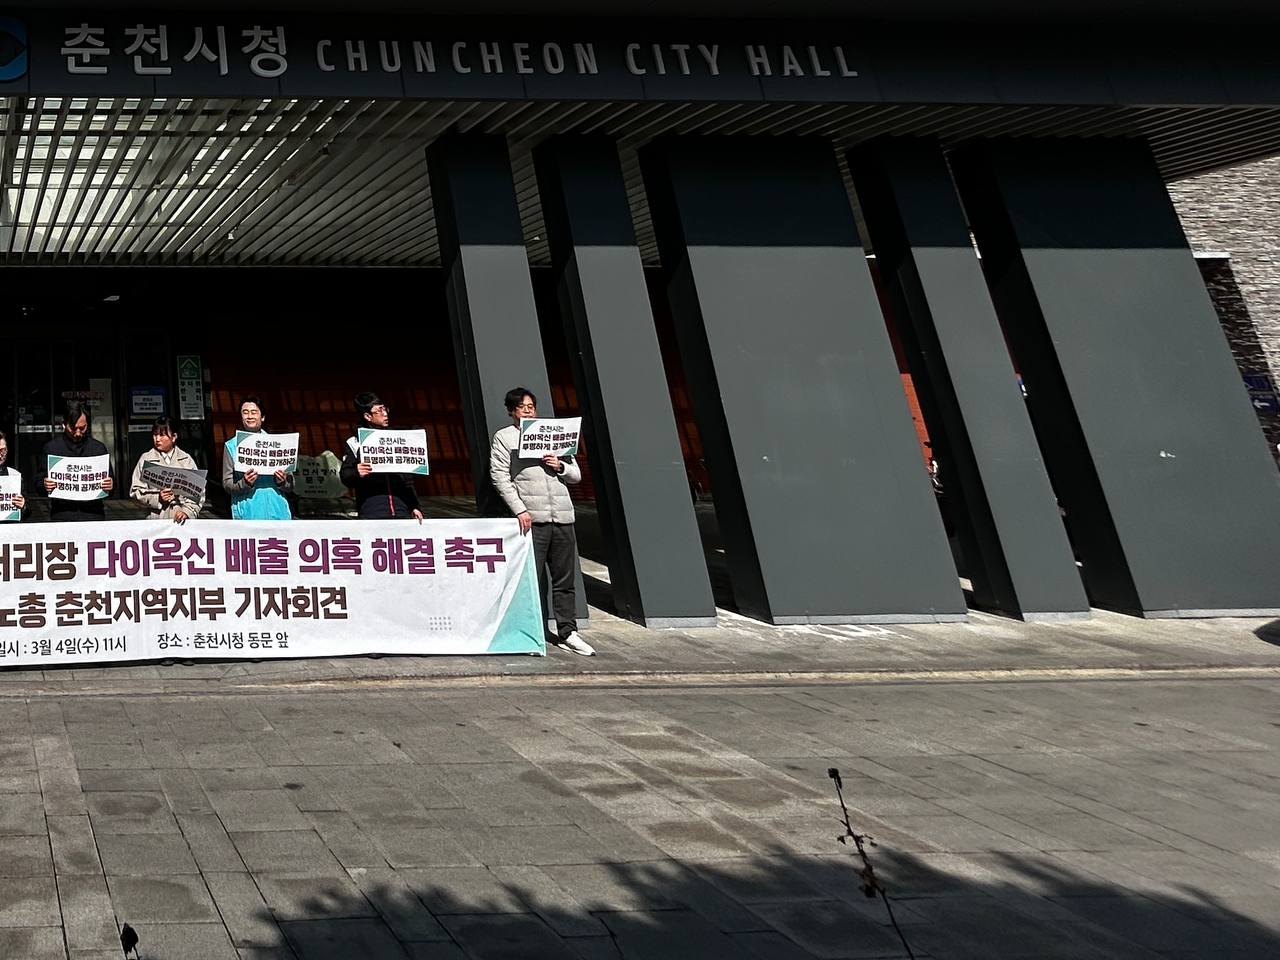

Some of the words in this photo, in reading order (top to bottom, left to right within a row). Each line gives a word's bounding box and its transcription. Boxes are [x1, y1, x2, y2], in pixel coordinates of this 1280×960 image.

[61, 22, 288, 78] 춘천시청
[315, 39, 600, 74] CHUNCHEON
[624, 42, 720, 76] CITY
[743, 44, 859, 78] HALL
[523, 433, 551, 442] 다이옥신
[238, 447, 267, 457] 다이옥신
[362, 446, 393, 454] 다이옥신
[51, 472, 79, 481] 다이옥신
[58, 482, 79, 491] 명하게
[81, 483, 102, 492] 공개하
[87, 537, 216, 578] 다이옥신
[224, 537, 290, 575] 배출
[298, 537, 363, 575] 의혹
[370, 537, 437, 575] 해결
[443, 536, 507, 574] 촉구
[55, 587, 227, 627] 춘천지역지부
[234, 585, 348, 620] 기자회견
[31, 638, 52, 656] 3월
[55, 637, 99, 656] 4일(수)
[103, 635, 127, 654] 11시
[157, 633, 183, 650] 장소
[193, 632, 245, 650] 춘천시청
[248, 632, 274, 649] 동문
[275, 631, 290, 649] 앞
